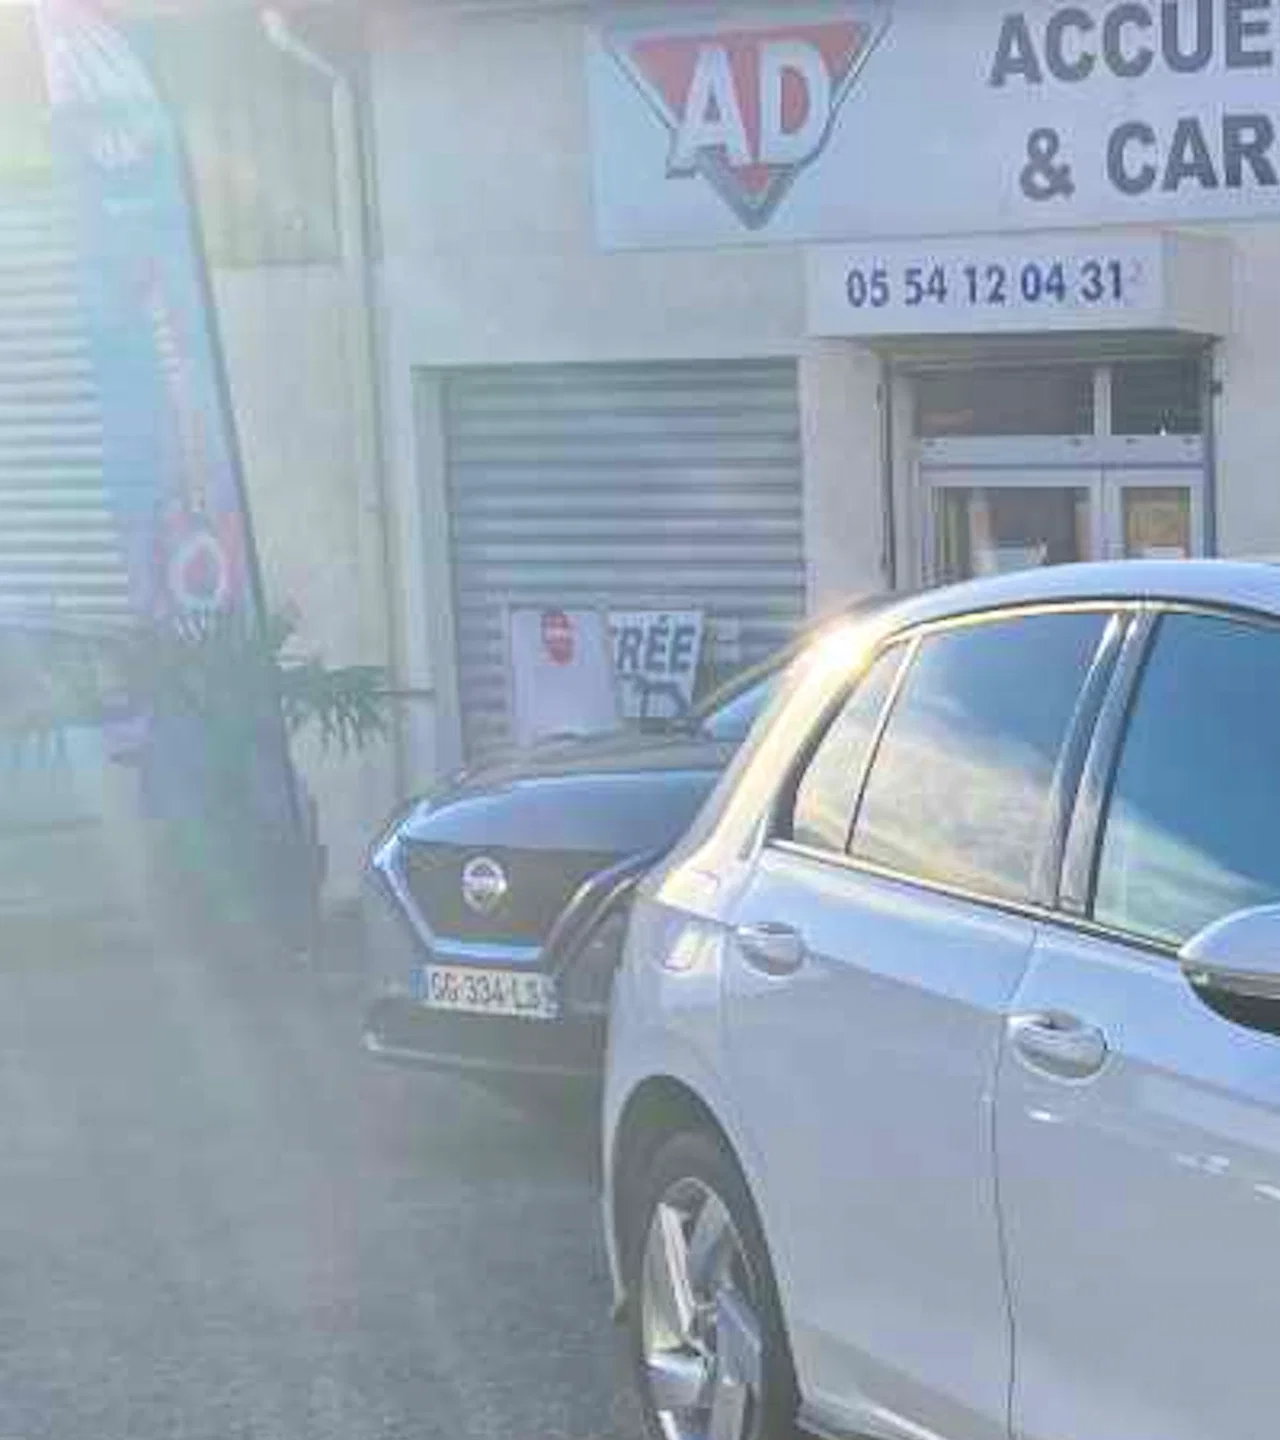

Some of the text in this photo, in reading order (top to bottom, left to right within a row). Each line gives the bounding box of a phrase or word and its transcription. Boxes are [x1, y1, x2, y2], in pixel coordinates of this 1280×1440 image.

[670, 40, 832, 169] AD
[1019, 127, 1076, 200] &
[846, 258, 1123, 308] 05 54 12 04 31
